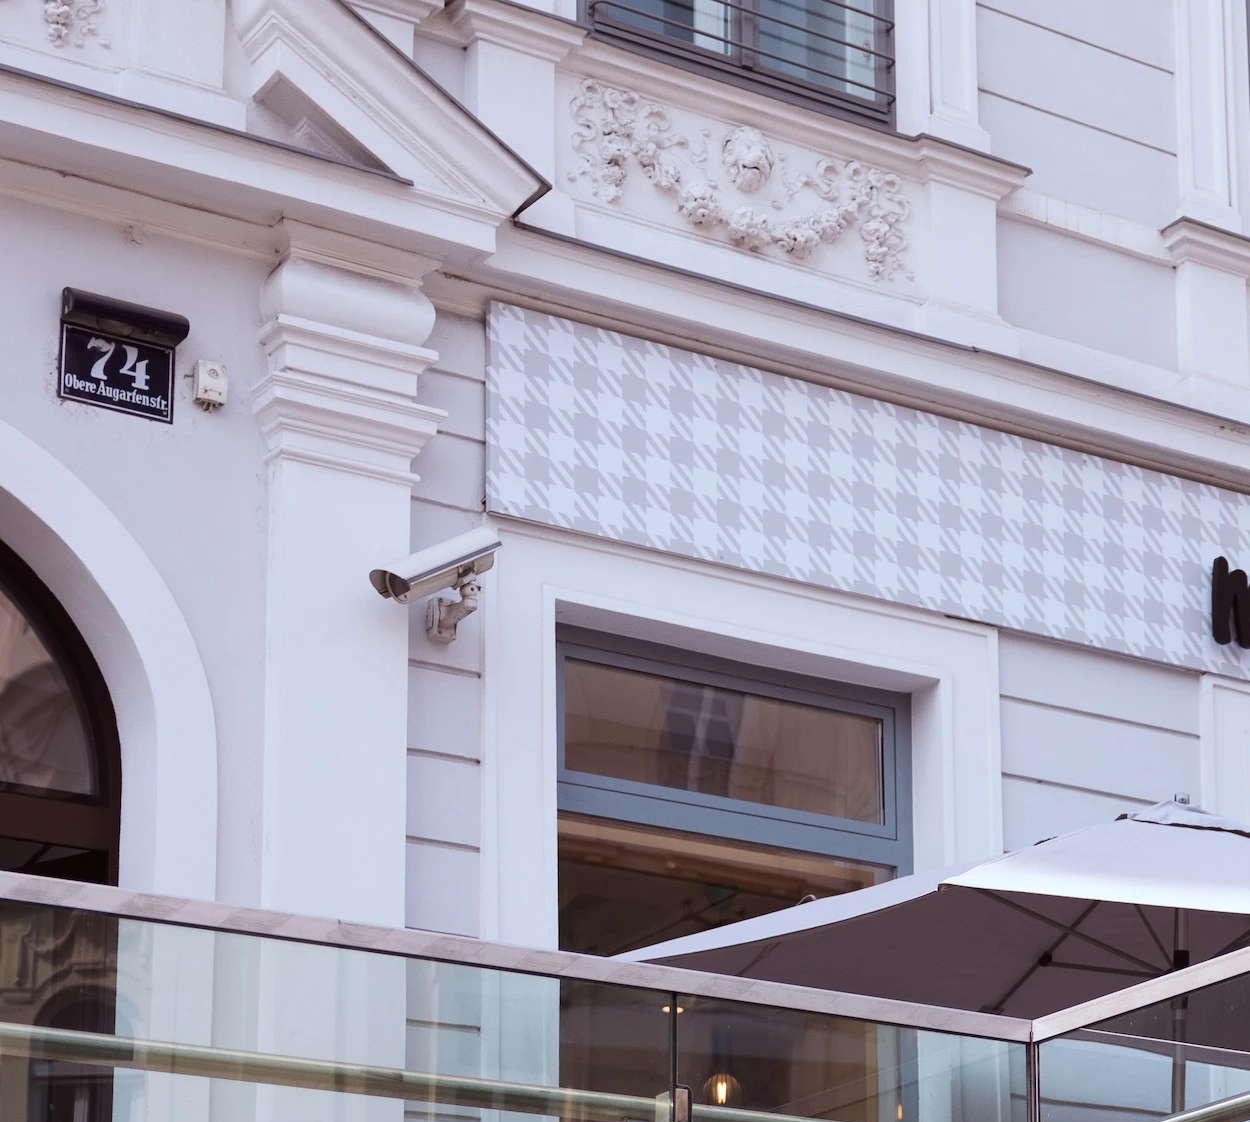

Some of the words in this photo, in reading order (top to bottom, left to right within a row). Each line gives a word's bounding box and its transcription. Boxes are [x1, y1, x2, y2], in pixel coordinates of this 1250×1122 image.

[87, 337, 150, 390] 74
[64, 373, 97, 393] Obere
[97, 381, 169, 411] Augartenstr.
